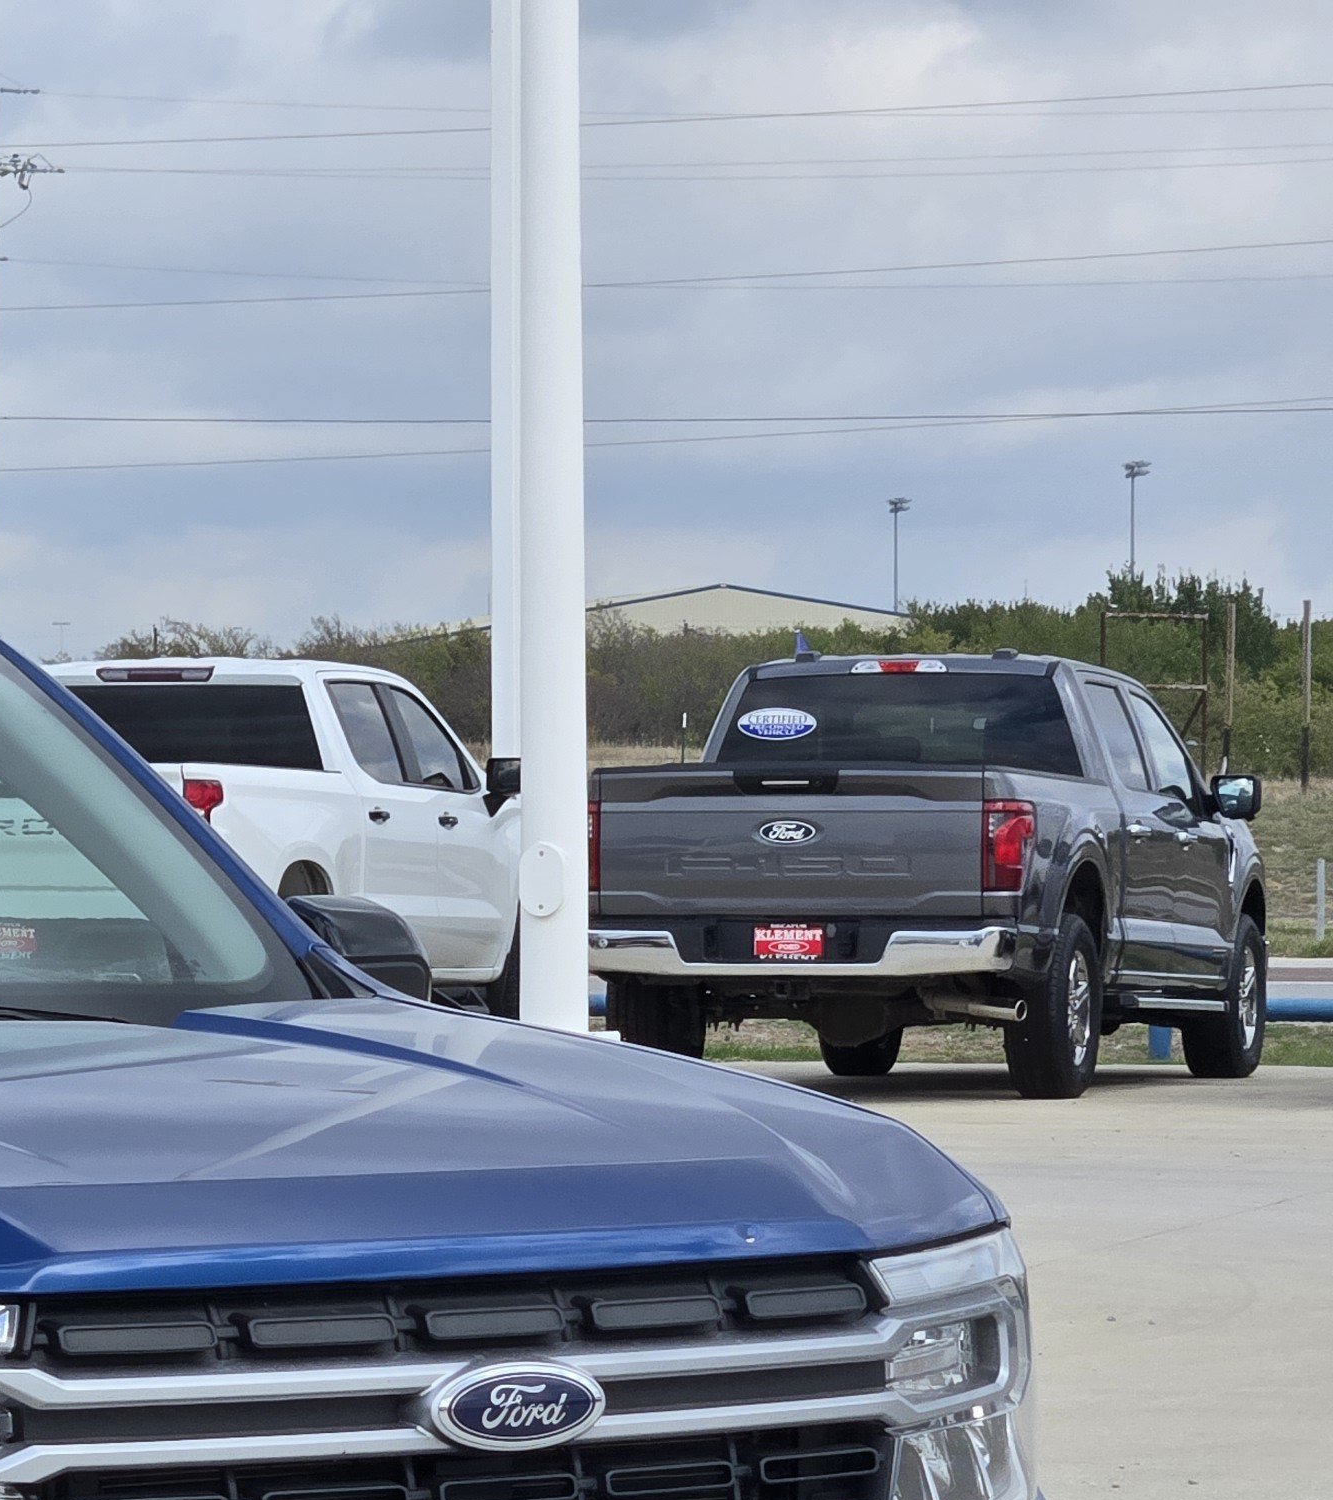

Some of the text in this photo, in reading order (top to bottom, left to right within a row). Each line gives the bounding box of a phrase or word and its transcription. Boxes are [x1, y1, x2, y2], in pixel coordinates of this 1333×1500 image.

[768, 823, 805, 840] Ford
[755, 929, 823, 941] KLEMENT
[482, 1384, 568, 1430] Ford
